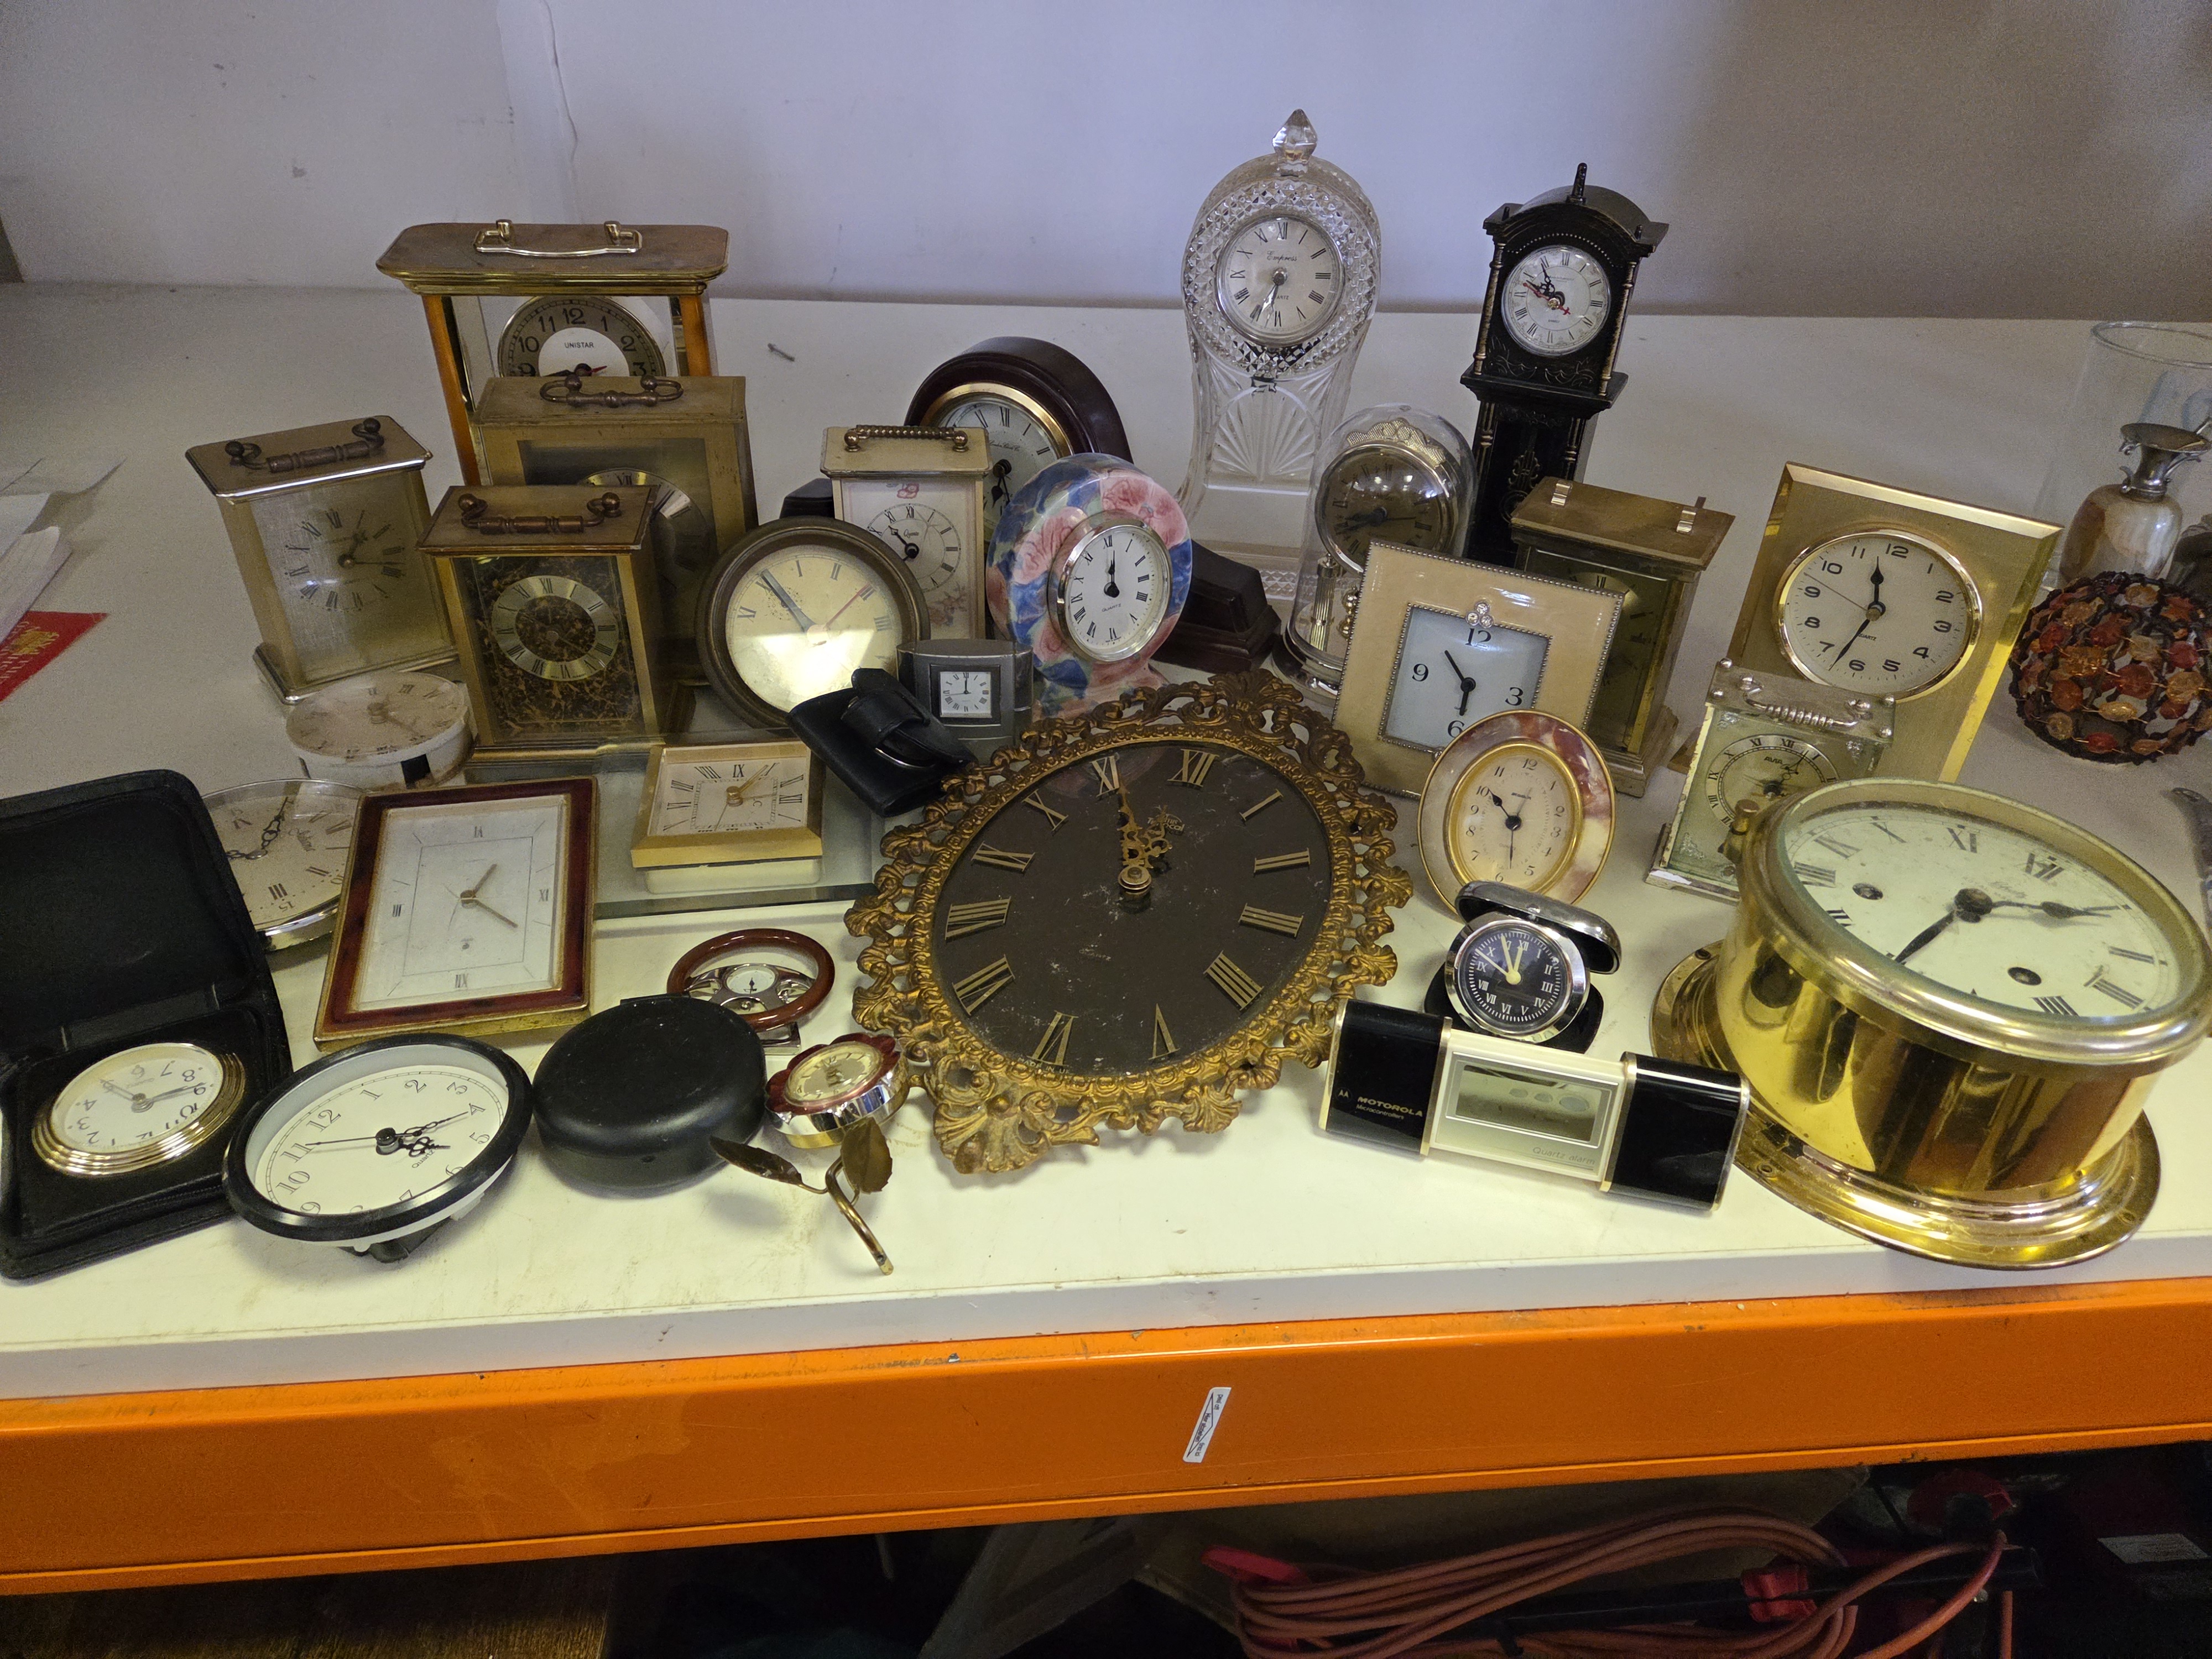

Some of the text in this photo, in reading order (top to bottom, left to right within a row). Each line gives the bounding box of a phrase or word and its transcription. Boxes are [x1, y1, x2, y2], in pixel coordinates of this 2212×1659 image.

[1277, 222, 1288, 239] XII
[1298, 229, 1308, 244] I
[1237, 246, 1253, 260] X
[1267, 251, 1297, 264] Empress
[1311, 248, 1327, 259] II
[562, 308, 586, 325] 12
[601, 315, 608, 332] 1
[539, 316, 556, 332] 11
[518, 336, 540, 353] 10
[620, 336, 637, 352] 2
[518, 363, 536, 377] 9
[633, 362, 647, 376] 3
[1000, 406, 1010, 428] XII
[884, 510, 896, 524] XI
[906, 506, 915, 519] XII
[927, 511, 935, 523] I
[869, 527, 883, 536] X
[1103, 534, 1113, 550] XII
[1125, 539, 1133, 553] I
[1851, 545, 1866, 559] 11
[1885, 543, 1910, 559] 12
[1135, 555, 1146, 567] II
[1822, 560, 1843, 575] 10
[1926, 562, 1934, 574] 1
[830, 562, 842, 581] II
[1138, 574, 1150, 583] III
[539, 577, 553, 594] XII
[1073, 576, 1084, 585] X
[1803, 586, 1821, 598] 9
[1935, 590, 1954, 603] 2
[1102, 603, 1121, 612] QUARTZ
[1804, 617, 1820, 629] 8
[1933, 620, 1952, 633] 3
[1465, 628, 1491, 651] 12
[1819, 640, 1835, 653] 7
[1912, 646, 1930, 660] 4
[1849, 659, 1866, 672] 6
[1882, 659, 1901, 672] 5
[1412, 664, 1429, 682] 9
[1505, 687, 1524, 706] 3
[1447, 720, 1465, 738] 6
[1749, 738, 1762, 748] XI
[1781, 738, 1795, 748] XII
[732, 764, 745, 778] IX
[1167, 749, 1220, 787] XII
[1522, 758, 1538, 771] 12
[1091, 755, 1120, 797] XI
[1494, 766, 1505, 778] 11
[1475, 785, 1490, 797] 10
[1550, 780, 1557, 791] 1
[1022, 789, 1070, 831] X
[1239, 789, 1284, 822] I
[1470, 805, 1479, 815] 9
[1553, 806, 1565, 817] 2
[1465, 825, 1476, 837] 8
[1550, 827, 1562, 838] 3
[1870, 820, 1907, 843] X
[1946, 827, 1978, 854] XI
[972, 841, 1036, 873] IX
[1471, 850, 1481, 861] 7
[1541, 847, 1552, 858] 4
[1254, 848, 1311, 874] II
[1495, 872, 1504, 883] 6
[1524, 865, 1536, 877] 5
[392, 903, 405, 917] III
[945, 896, 1012, 941] VIII
[1238, 902, 1304, 938] III
[1487, 946, 1496, 957] X
[1517, 940, 1529, 952] XII
[1536, 949, 1542, 959] I
[2107, 945, 2155, 965] II
[1477, 961, 1488, 973] IX
[1544, 964, 1553, 975] II
[952, 954, 1016, 1016] VII
[1203, 951, 1264, 1011] IIII
[1478, 979, 1489, 992] VIII
[1541, 981, 1554, 993] III
[1486, 993, 1497, 1005] VII
[2092, 977, 2146, 1010] III
[1501, 1003, 1512, 1015] VI
[1534, 997, 1546, 1009] IV
[1521, 1005, 1530, 1016] V
[1027, 1010, 1079, 1067] VI
[1151, 1003, 1181, 1060] V
[160, 1063, 174, 1077] 7
[182, 1069, 195, 1082] 8
[193, 1086, 206, 1095] 9
[404, 1079, 427, 1094] 2
[446, 1081, 468, 1095] 3
[359, 1089, 383, 1102] 1
[83, 1099, 97, 1112] 4
[180, 1102, 198, 1119] 10
[467, 1103, 487, 1117] 4
[1357, 1096, 1423, 1118] MOTOROLA
[77, 1116, 90, 1130] 3
[305, 1108, 342, 1133] 12
[87, 1130, 100, 1144] 2
[469, 1131, 491, 1145] 5
[280, 1141, 315, 1164] 11
[411, 1149, 436, 1168] Quartz
[1532, 1146, 1596, 1165] Quartz alarm
[275, 1170, 311, 1196] 10
